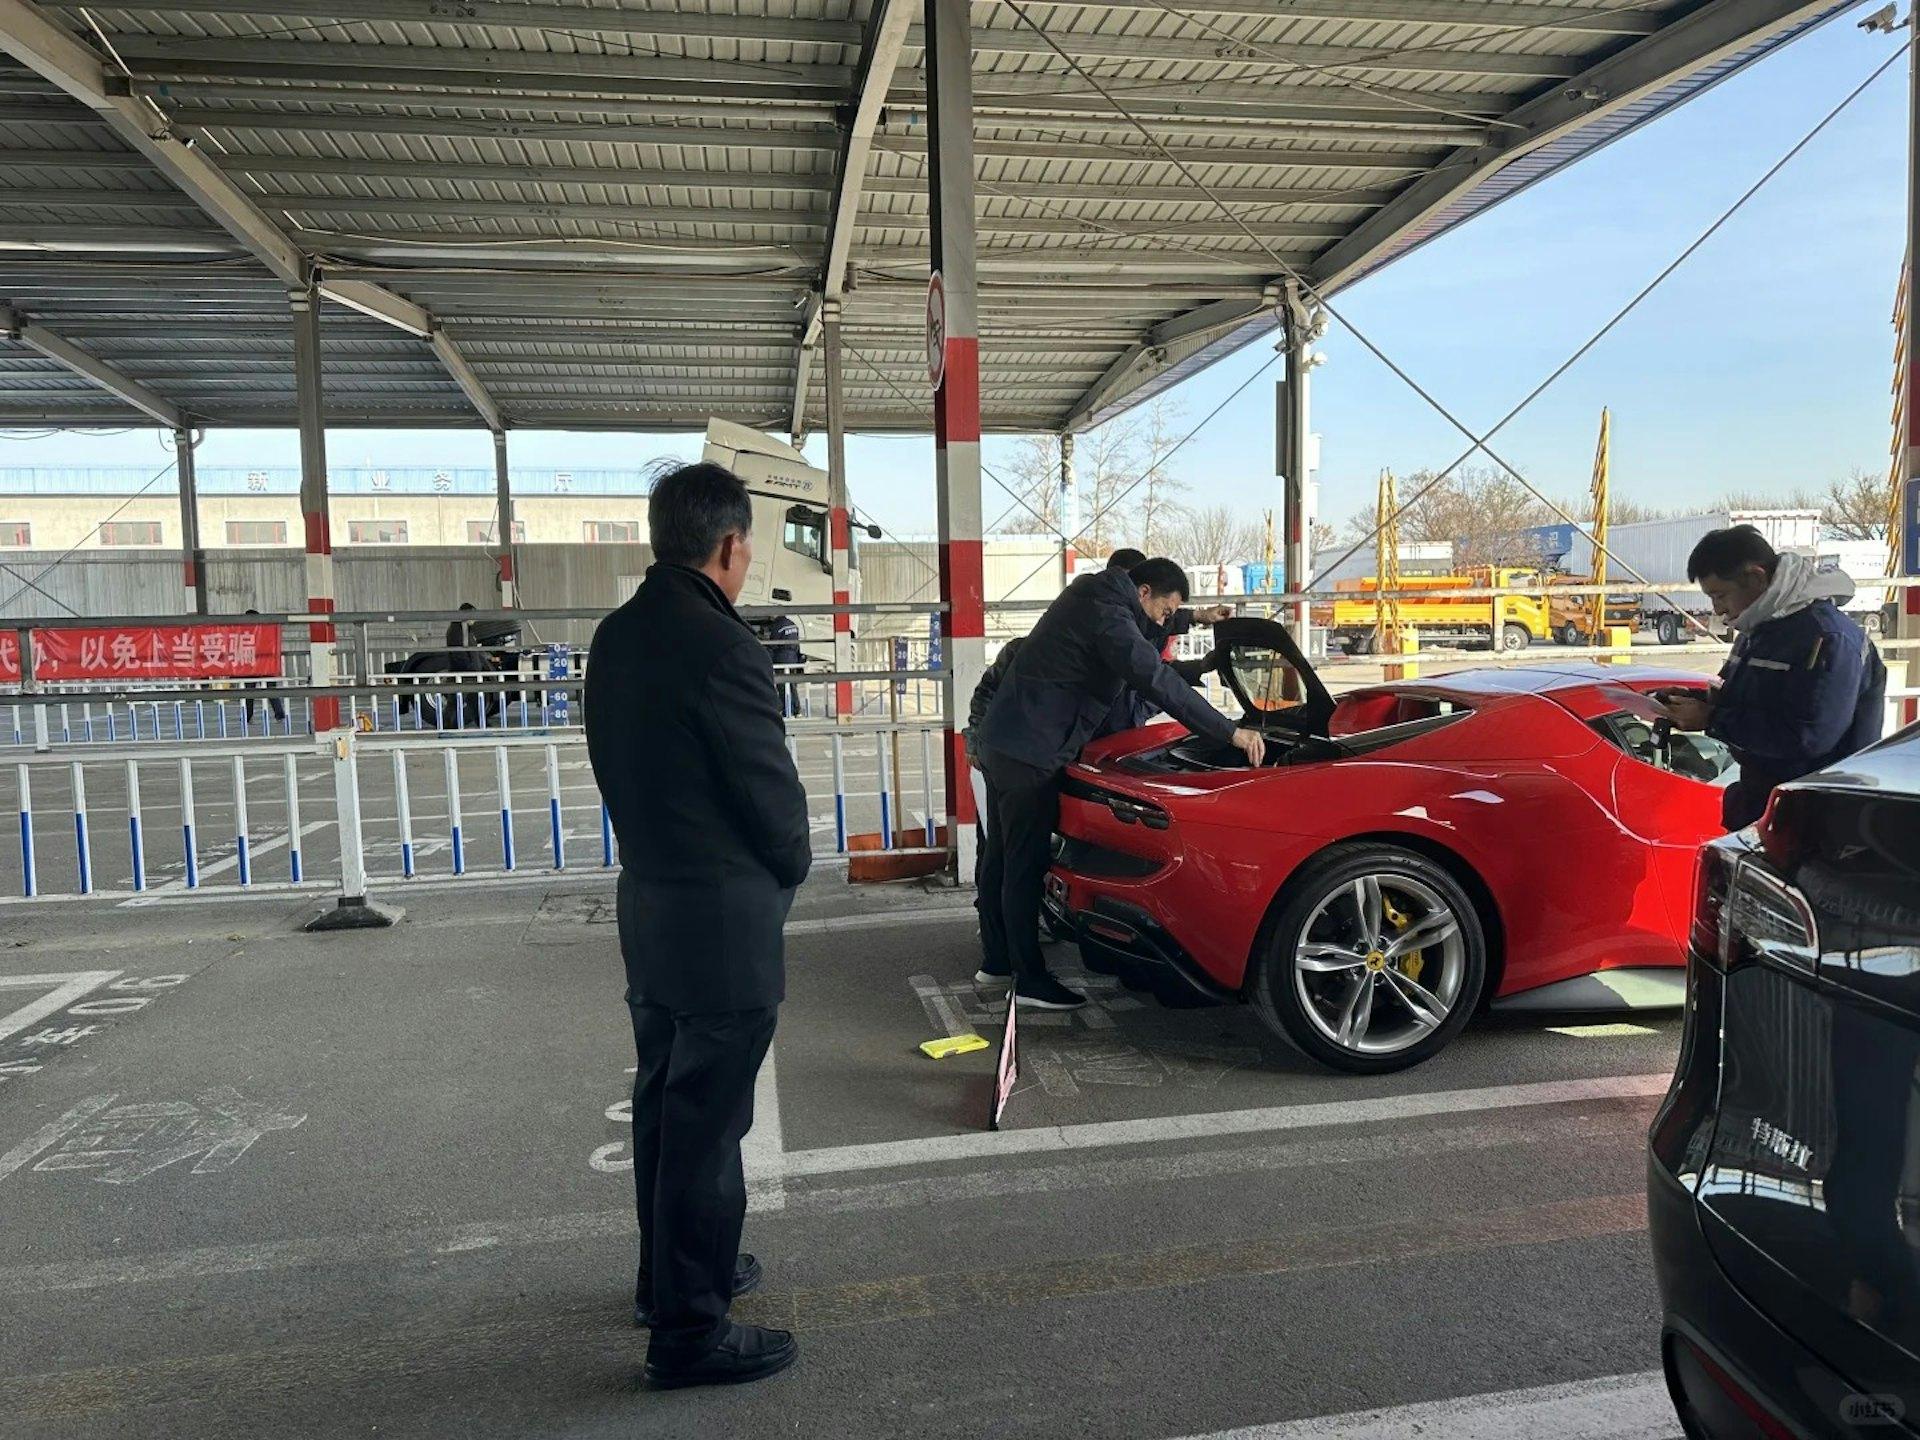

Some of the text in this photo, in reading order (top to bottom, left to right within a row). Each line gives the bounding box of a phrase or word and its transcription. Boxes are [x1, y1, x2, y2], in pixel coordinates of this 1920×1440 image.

[554, 658, 568, 668] 20
[554, 692, 568, 701] 60
[555, 709, 568, 719] 80
